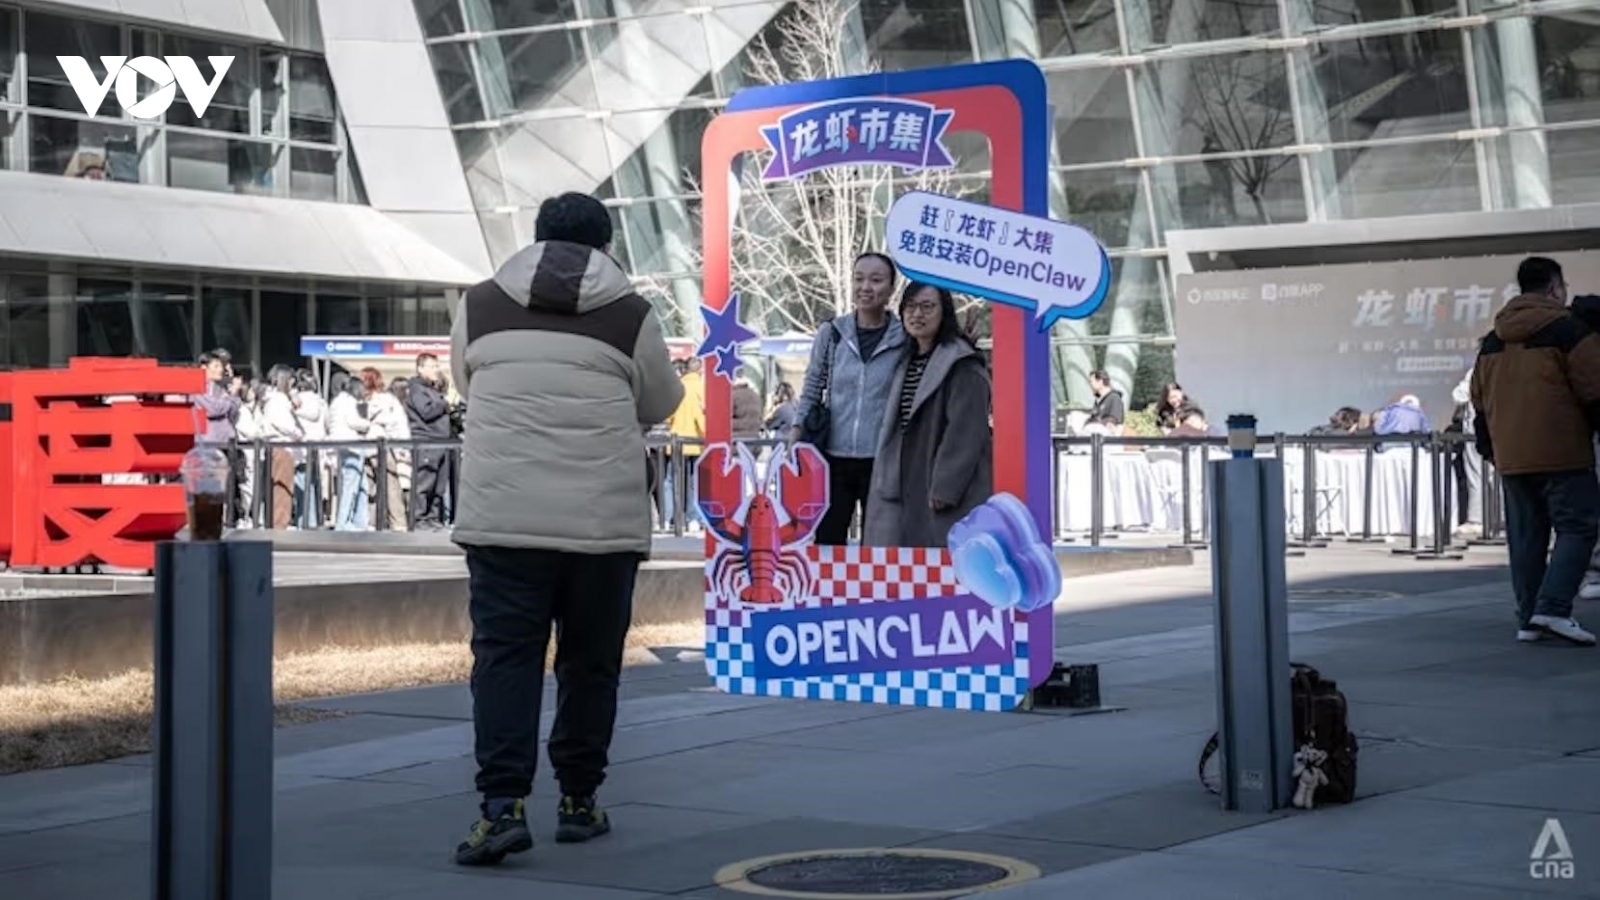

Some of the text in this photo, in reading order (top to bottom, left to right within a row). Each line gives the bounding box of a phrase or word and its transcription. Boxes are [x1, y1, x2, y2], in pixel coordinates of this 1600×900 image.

[790, 108, 924, 163] 龙虾市集
[898, 229, 1086, 292] 免费安装OpenClaw
[1351, 284, 1519, 331] 龙虾市
[765, 609, 1005, 666] OPENCLAW
